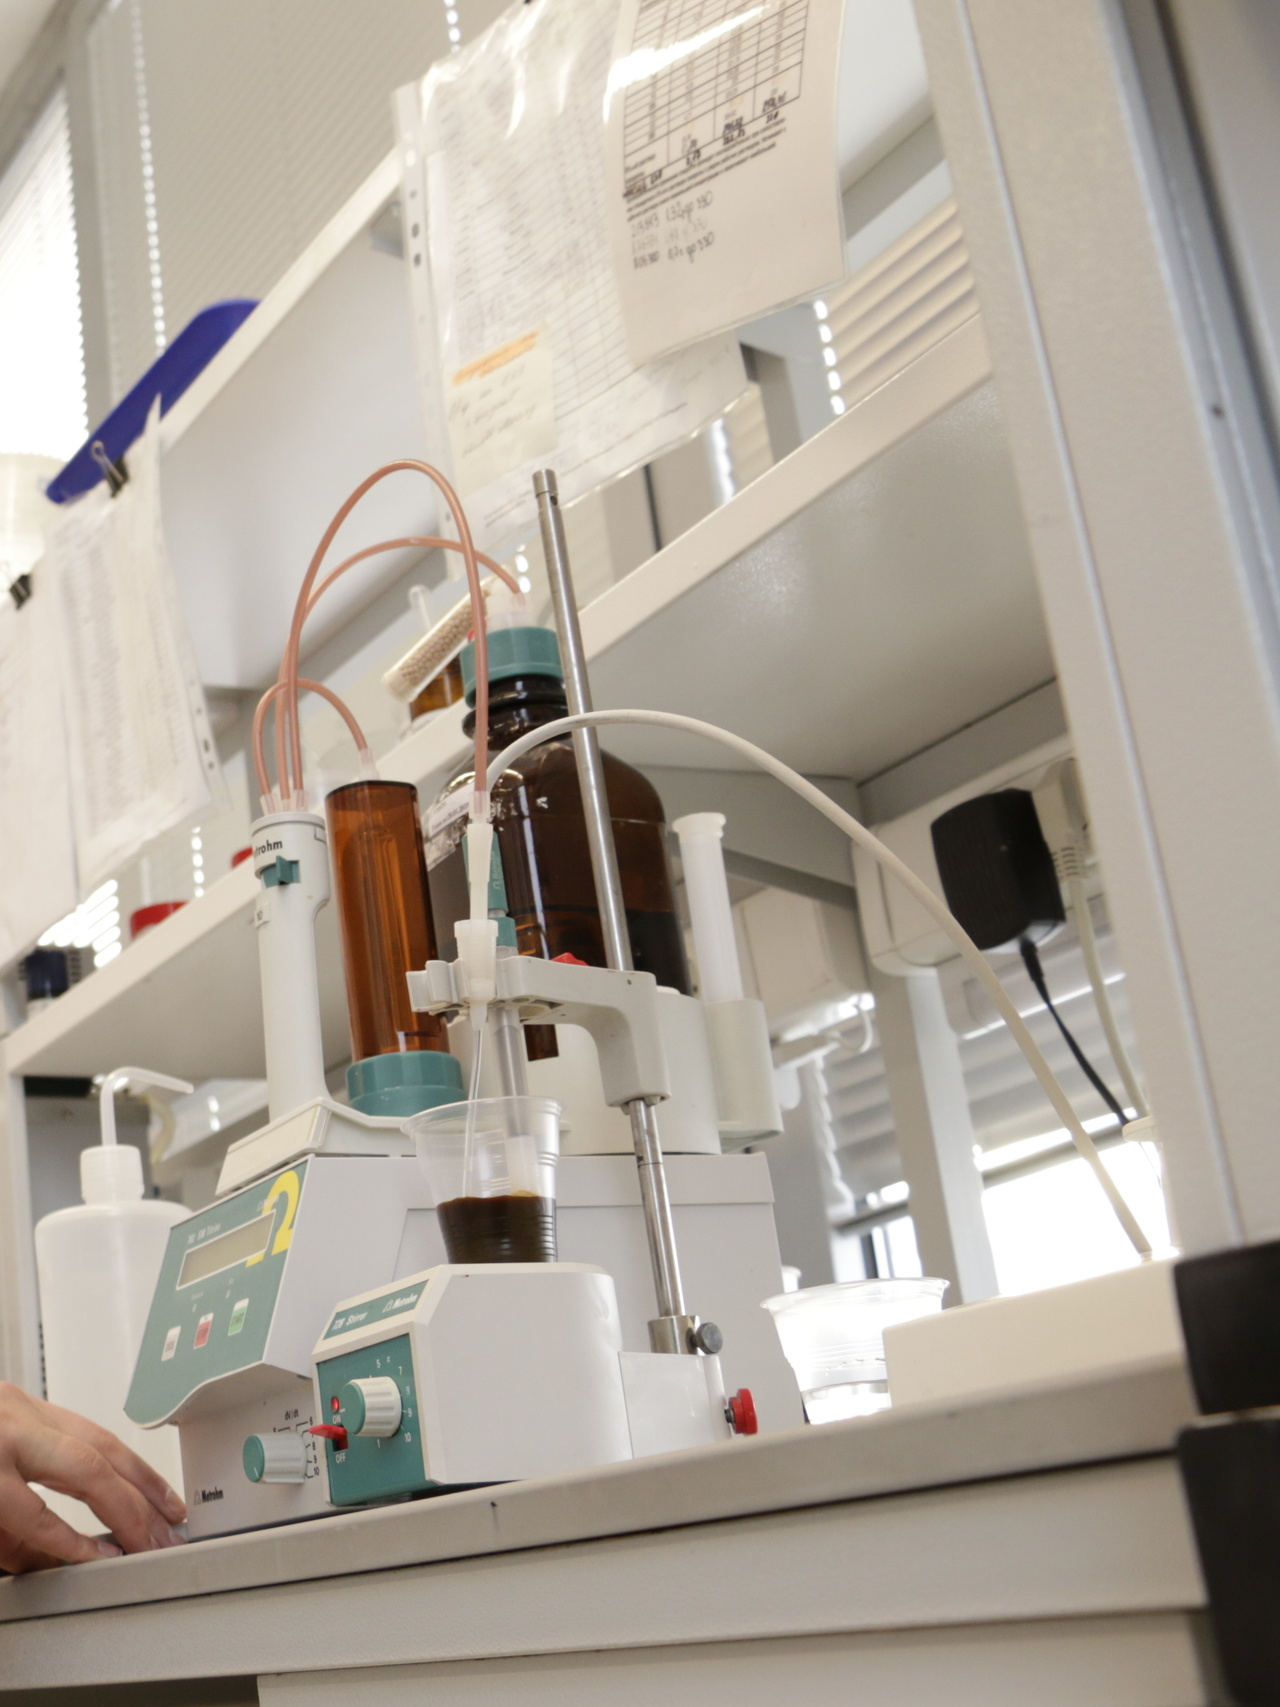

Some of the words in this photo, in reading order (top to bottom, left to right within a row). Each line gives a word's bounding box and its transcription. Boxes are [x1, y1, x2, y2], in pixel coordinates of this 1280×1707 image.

[245, 1169, 300, 1268] 2
[346, 1311, 369, 1326] Stirrer
[393, 1293, 419, 1309] Metrohm
[376, 1358, 381, 1369] 5
[398, 1366, 403, 1376] 7
[407, 1407, 413, 1418] 9
[332, 1414, 342, 1425] ON
[404, 1431, 412, 1443] 10
[335, 1452, 346, 1464] OFF
[313, 1466, 320, 1477] 10
[202, 1486, 223, 1502] Metrohm
